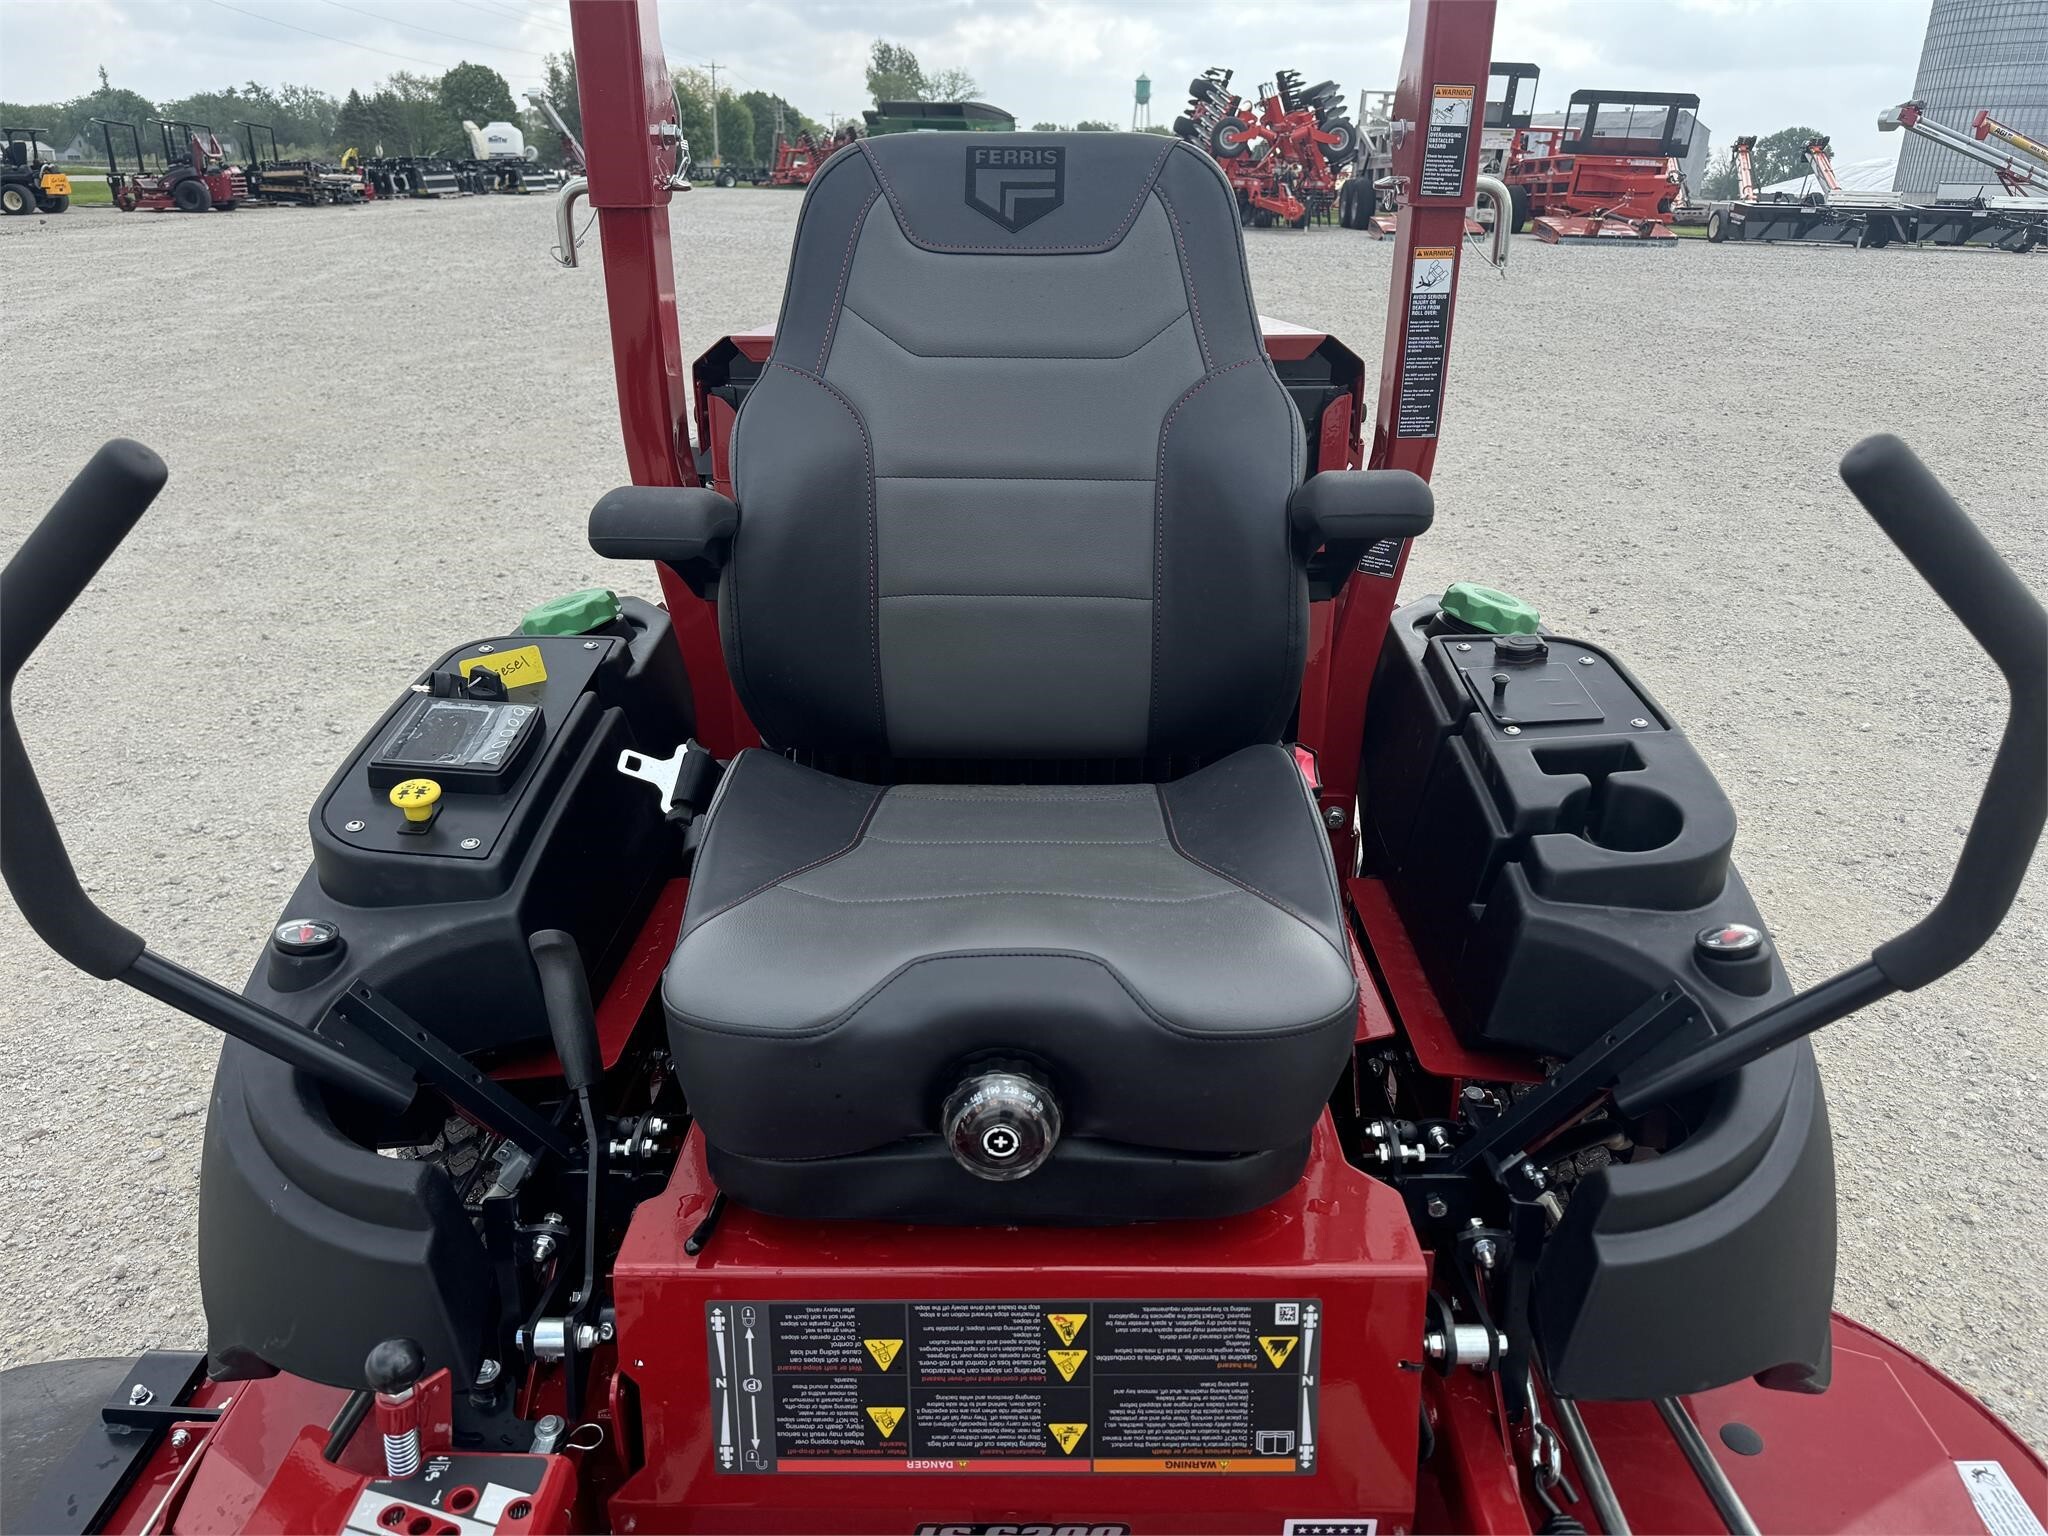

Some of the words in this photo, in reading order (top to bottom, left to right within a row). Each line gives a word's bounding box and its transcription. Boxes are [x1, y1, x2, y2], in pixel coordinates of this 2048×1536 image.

[1442, 88, 1472, 96] WARNING
[975, 150, 1057, 164] FERRIS
[495, 656, 530, 676] esel
[986, 1086, 1000, 1095] 190
[1004, 1086, 1019, 1095] 235
[716, 1378, 726, 1387] N
[1302, 1375, 1313, 1385] N
[1165, 1460, 1217, 1469] WARNING
